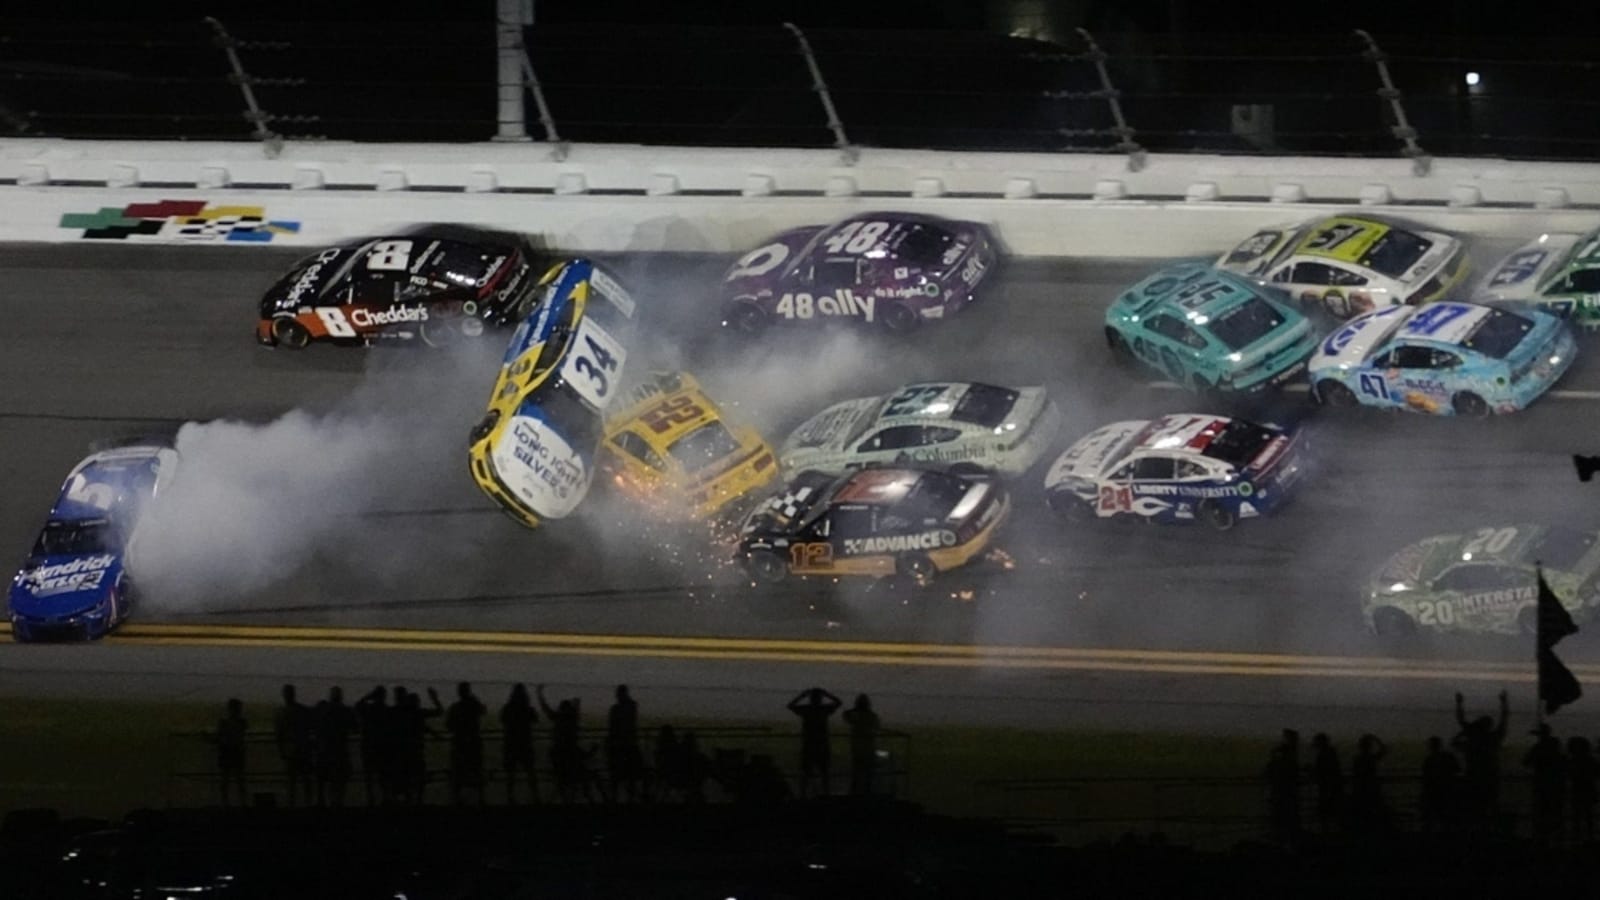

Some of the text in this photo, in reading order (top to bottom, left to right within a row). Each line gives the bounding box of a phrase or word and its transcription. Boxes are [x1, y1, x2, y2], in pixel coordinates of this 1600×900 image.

[824, 221, 889, 253] 48
[367, 240, 413, 271] 8
[315, 304, 428, 337] 8 Cheddar's
[776, 289, 875, 322] 48 ally
[575, 333, 619, 398] 34
[1360, 372, 1390, 400] 47
[512, 425, 550, 458] LONG
[912, 443, 986, 462] Columbia
[1101, 486, 1131, 511] 24
[1133, 484, 1178, 496] LIBERTY
[790, 531, 941, 567] 12 ADVANCE
[1463, 527, 1519, 554] 20
[1417, 601, 1454, 625] 20
